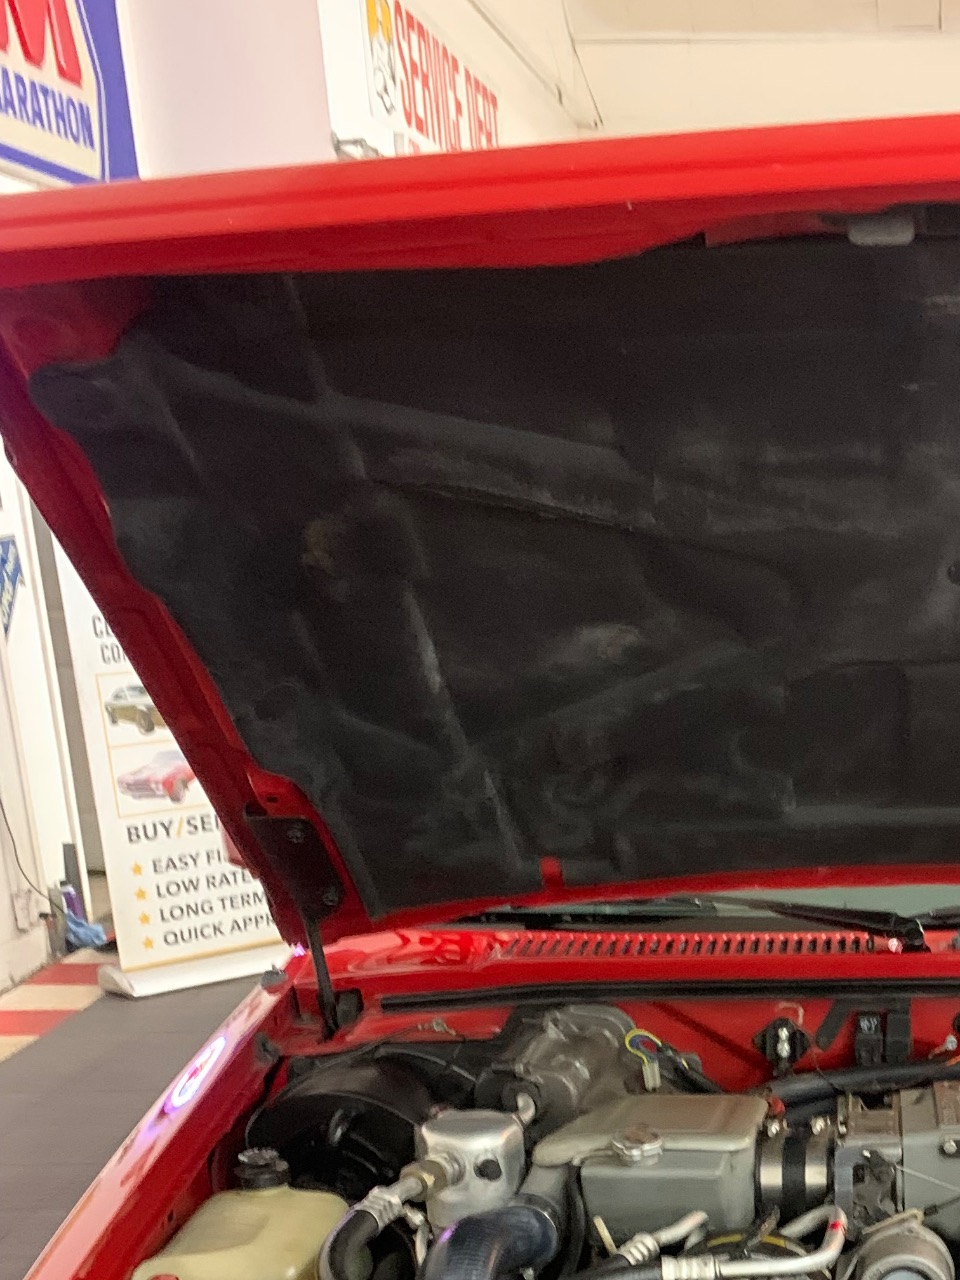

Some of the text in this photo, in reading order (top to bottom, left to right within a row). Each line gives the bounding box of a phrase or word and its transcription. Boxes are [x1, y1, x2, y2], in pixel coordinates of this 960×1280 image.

[394, 0, 463, 152] SERVICE
[0, 64, 96, 152] ARATHON
[152, 851, 200, 874] EASY
[156, 877, 201, 899] LOW
[160, 899, 214, 923] LONG
[163, 921, 225, 947] QUICK
